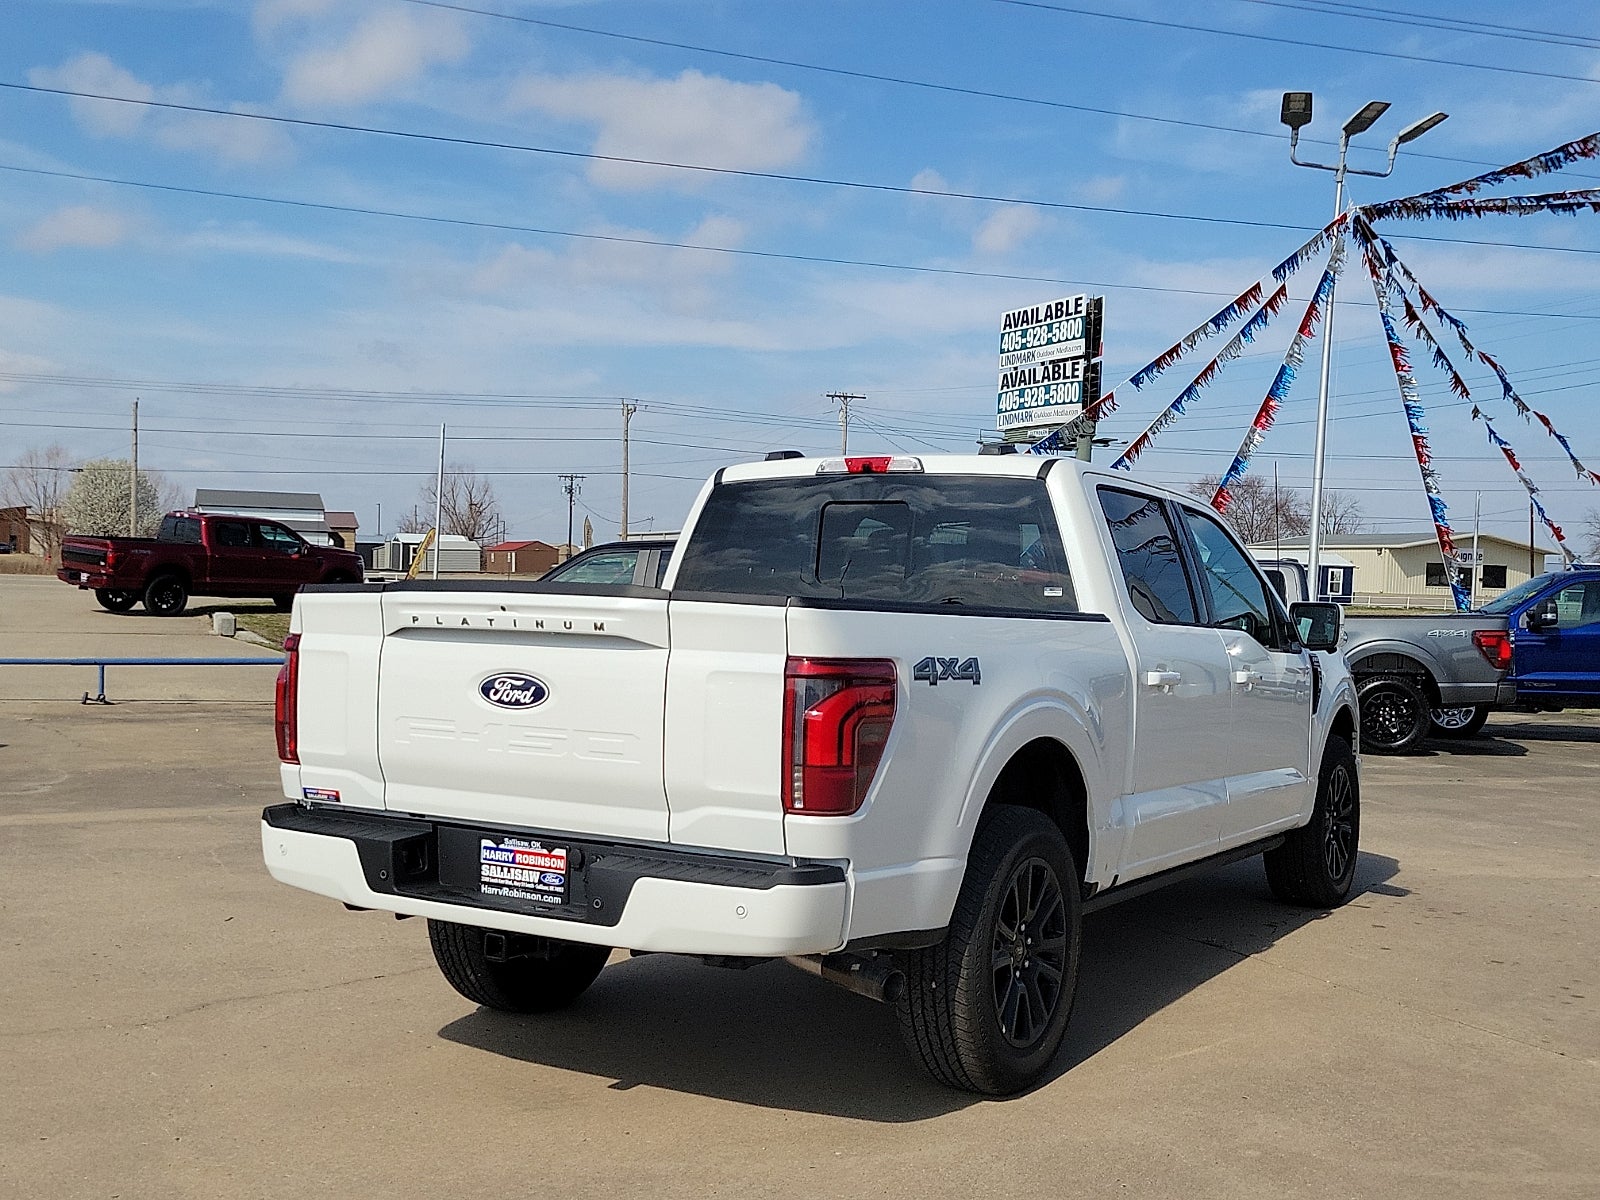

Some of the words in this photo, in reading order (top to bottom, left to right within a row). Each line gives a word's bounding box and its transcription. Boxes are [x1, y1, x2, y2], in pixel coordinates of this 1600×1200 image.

[1003, 296, 1083, 331] AVAILABLE
[1001, 318, 1082, 352] 405-928-5800
[1000, 350, 1036, 367] LINDMARK
[1001, 361, 1079, 390] AVAILABLE
[999, 382, 1079, 411] 405-928-5800
[998, 410, 1033, 426] LINDMARK
[412, 616, 605, 632] PLATINUM
[488, 676, 537, 704] Ford
[531, 841, 541, 849] OK
[483, 848, 514, 862] HARRY
[515, 853, 564, 869] ROBINSON
[481, 864, 540, 883] SALLISAW
[481, 884, 562, 904] HarryRobinson.com
